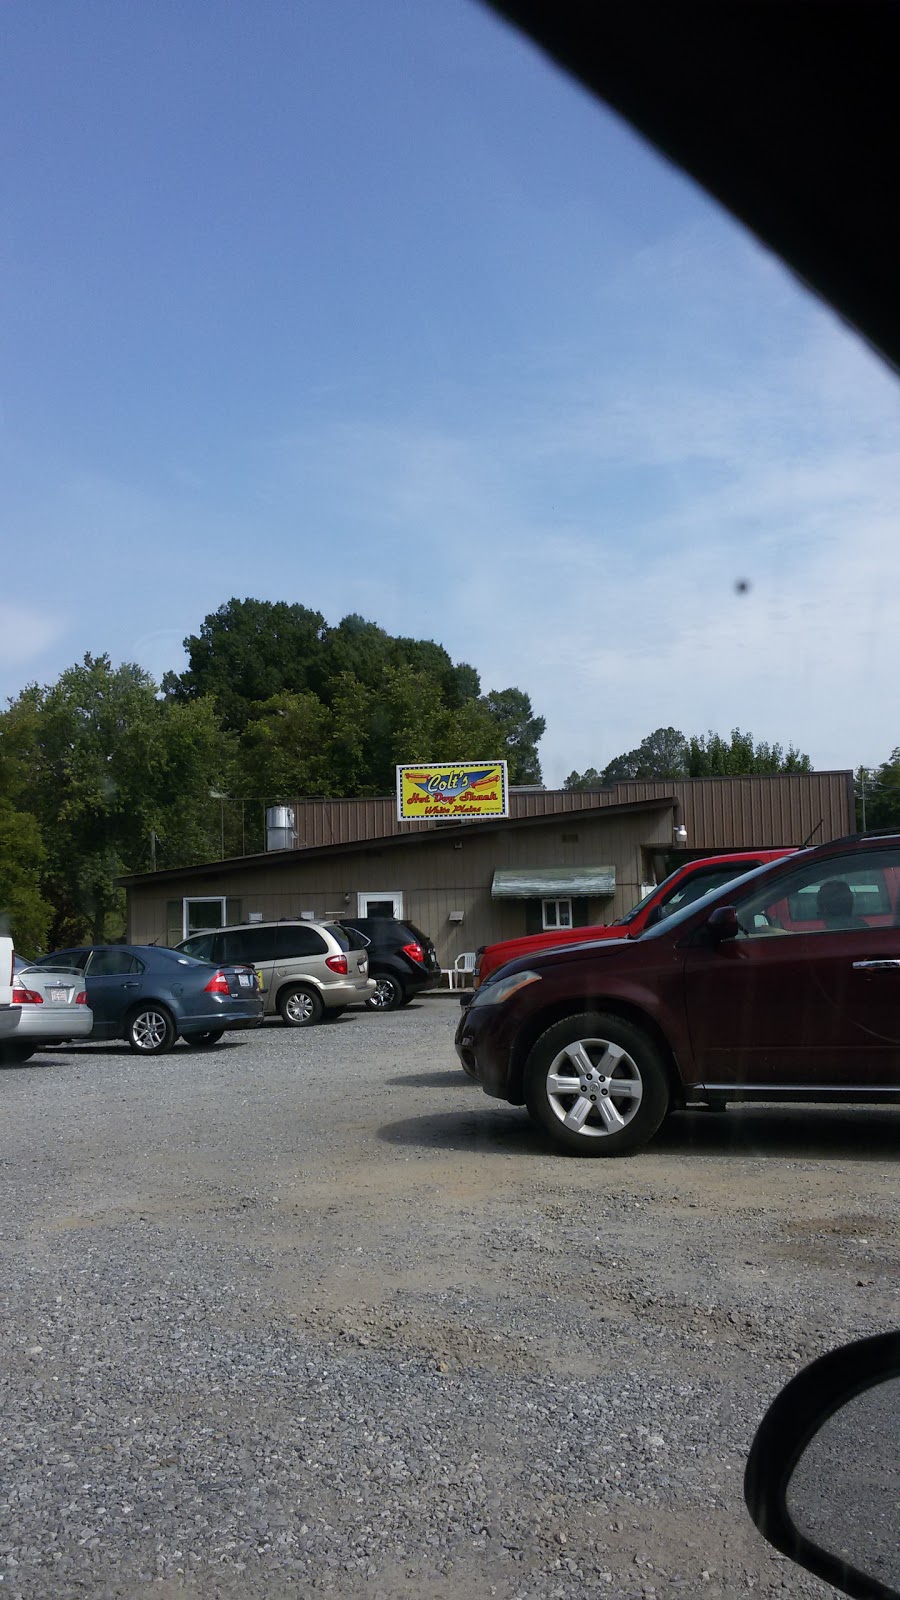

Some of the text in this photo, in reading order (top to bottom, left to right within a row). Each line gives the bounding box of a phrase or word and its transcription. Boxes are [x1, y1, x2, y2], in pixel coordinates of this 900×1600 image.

[428, 770, 468, 792] Colt's
[407, 791, 498, 805] Hot Dog Shack
[425, 806, 450, 814] White
[452, 804, 482, 813] Plains
